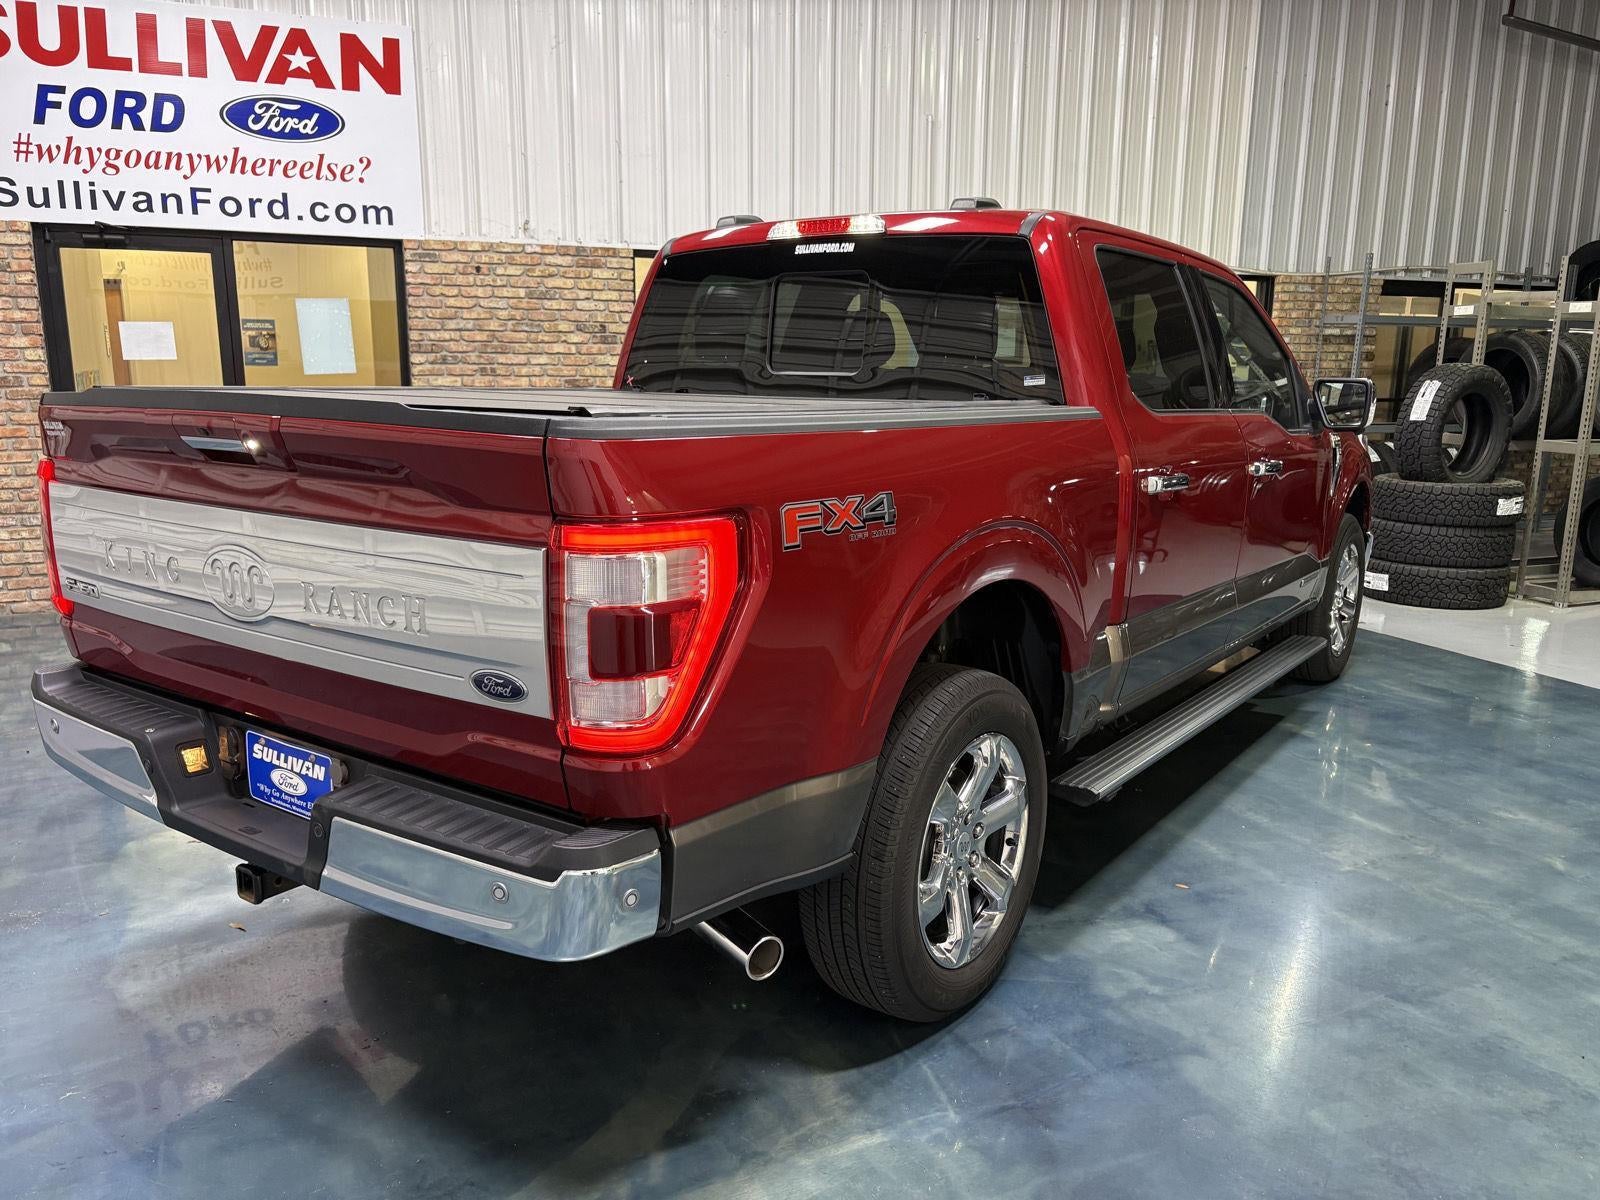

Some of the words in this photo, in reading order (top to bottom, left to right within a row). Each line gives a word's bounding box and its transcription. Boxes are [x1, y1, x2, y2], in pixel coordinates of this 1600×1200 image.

[0, 0, 402, 96] ULLIVAN
[33, 83, 185, 134] FORD
[248, 100, 320, 136] Ford
[13, 132, 372, 184] #whygoanywhereelse?
[0, 176, 394, 227] SullivanFord.com
[795, 242, 855, 254] SULLIVANFORD.COM
[780, 490, 897, 552] FX4
[103, 538, 180, 584] KING
[301, 581, 429, 636] RANCH
[481, 675, 512, 698] Ford
[253, 743, 325, 781] SULLIVAN
[277, 772, 300, 792] Ford
[281, 792, 307, 807] Anywhere
